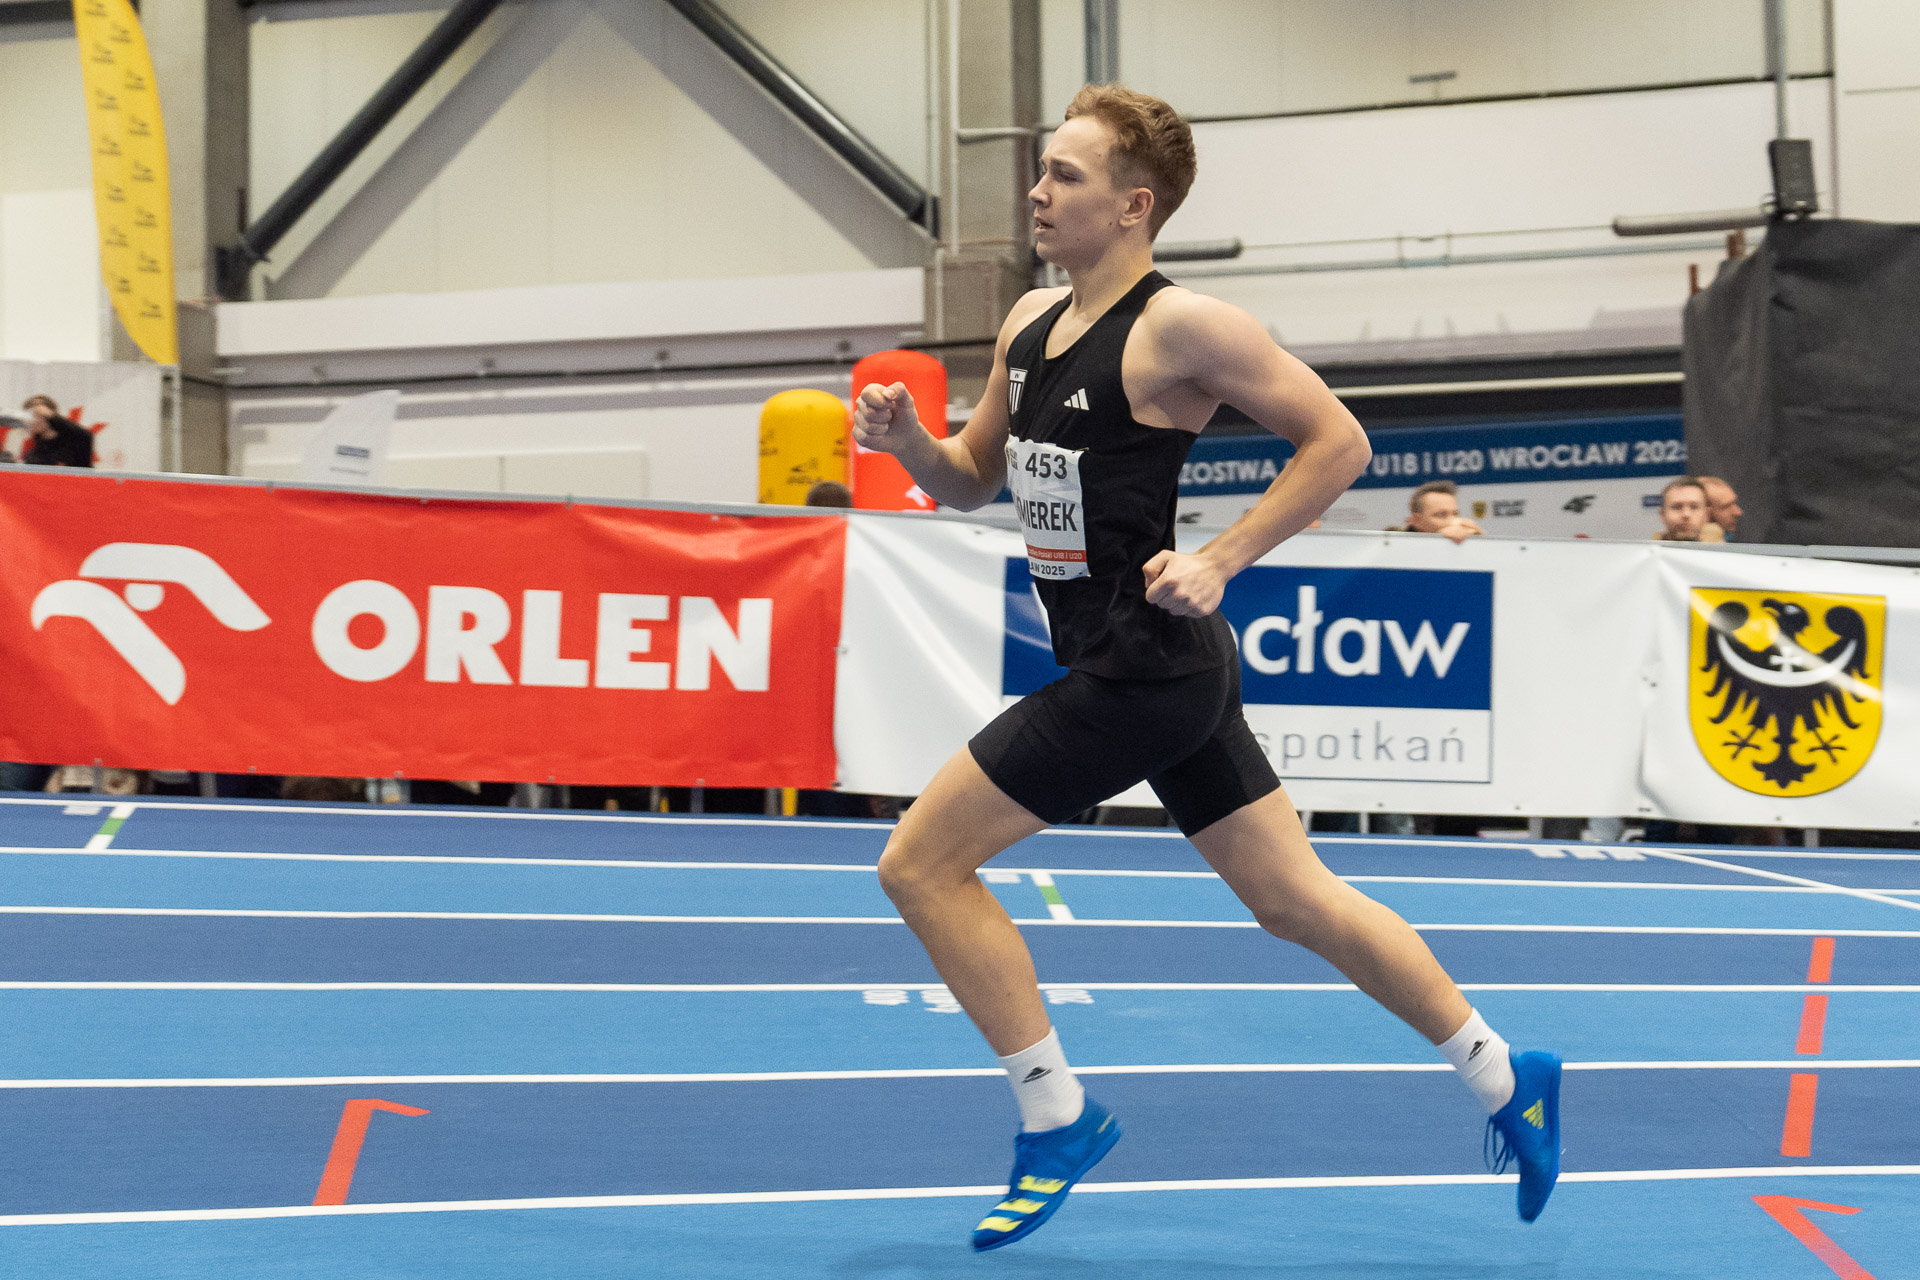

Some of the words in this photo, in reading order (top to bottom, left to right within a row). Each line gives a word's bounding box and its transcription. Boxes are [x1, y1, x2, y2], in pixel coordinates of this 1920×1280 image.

[1025, 452, 1067, 480] 453
[1373, 452, 1419, 477] U18
[1437, 449, 1483, 473] U20
[1041, 564, 1066, 576] 2025
[1069, 552, 1082, 560] U20
[311, 579, 773, 691] ORLEN
[1230, 585, 1471, 679] cław
